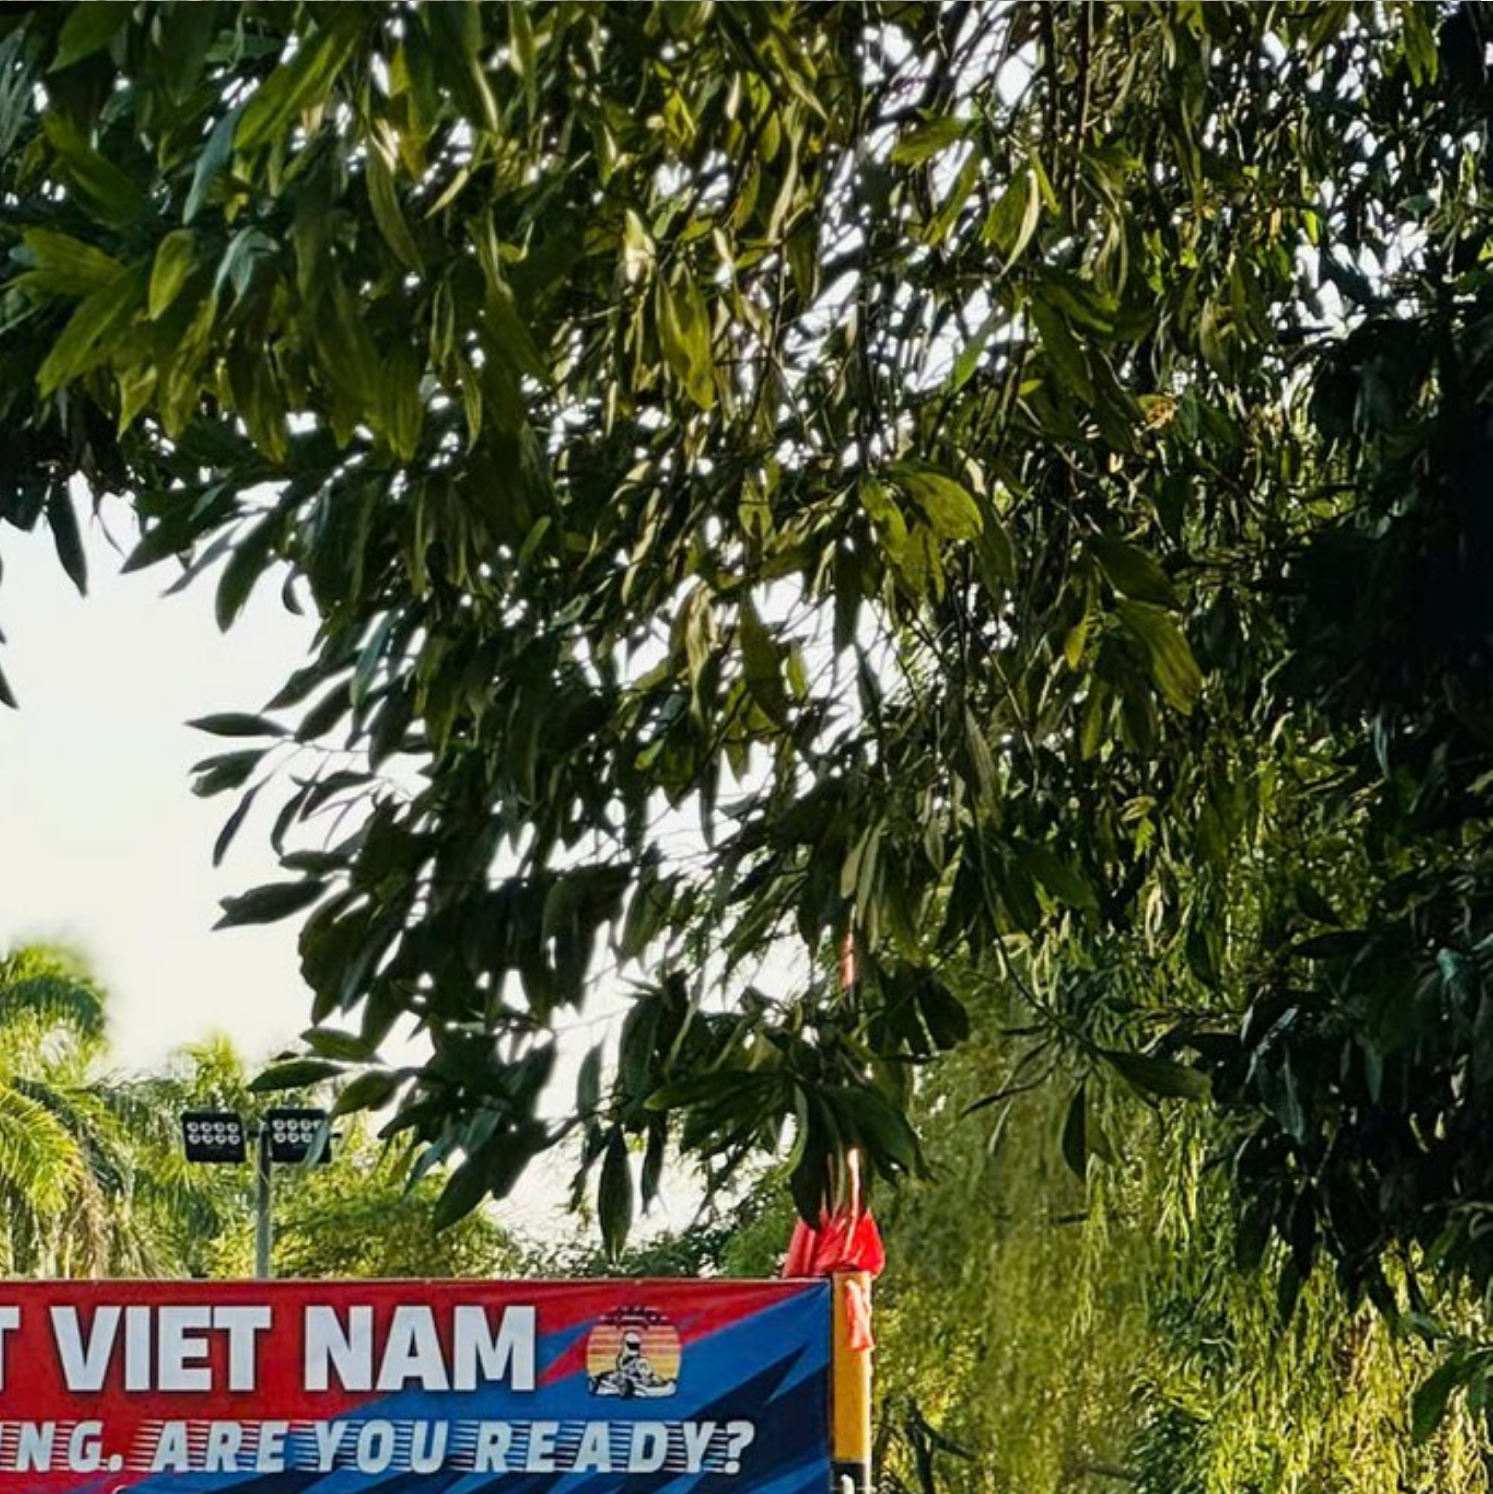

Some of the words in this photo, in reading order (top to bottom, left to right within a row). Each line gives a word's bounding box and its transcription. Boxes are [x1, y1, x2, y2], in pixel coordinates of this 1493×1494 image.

[49, 1305, 272, 1392] VIET
[303, 1305, 536, 1392] NAM
[148, 1420, 292, 1473] ARE
[314, 1420, 452, 1473] YOU
[472, 1420, 755, 1475] READY?
